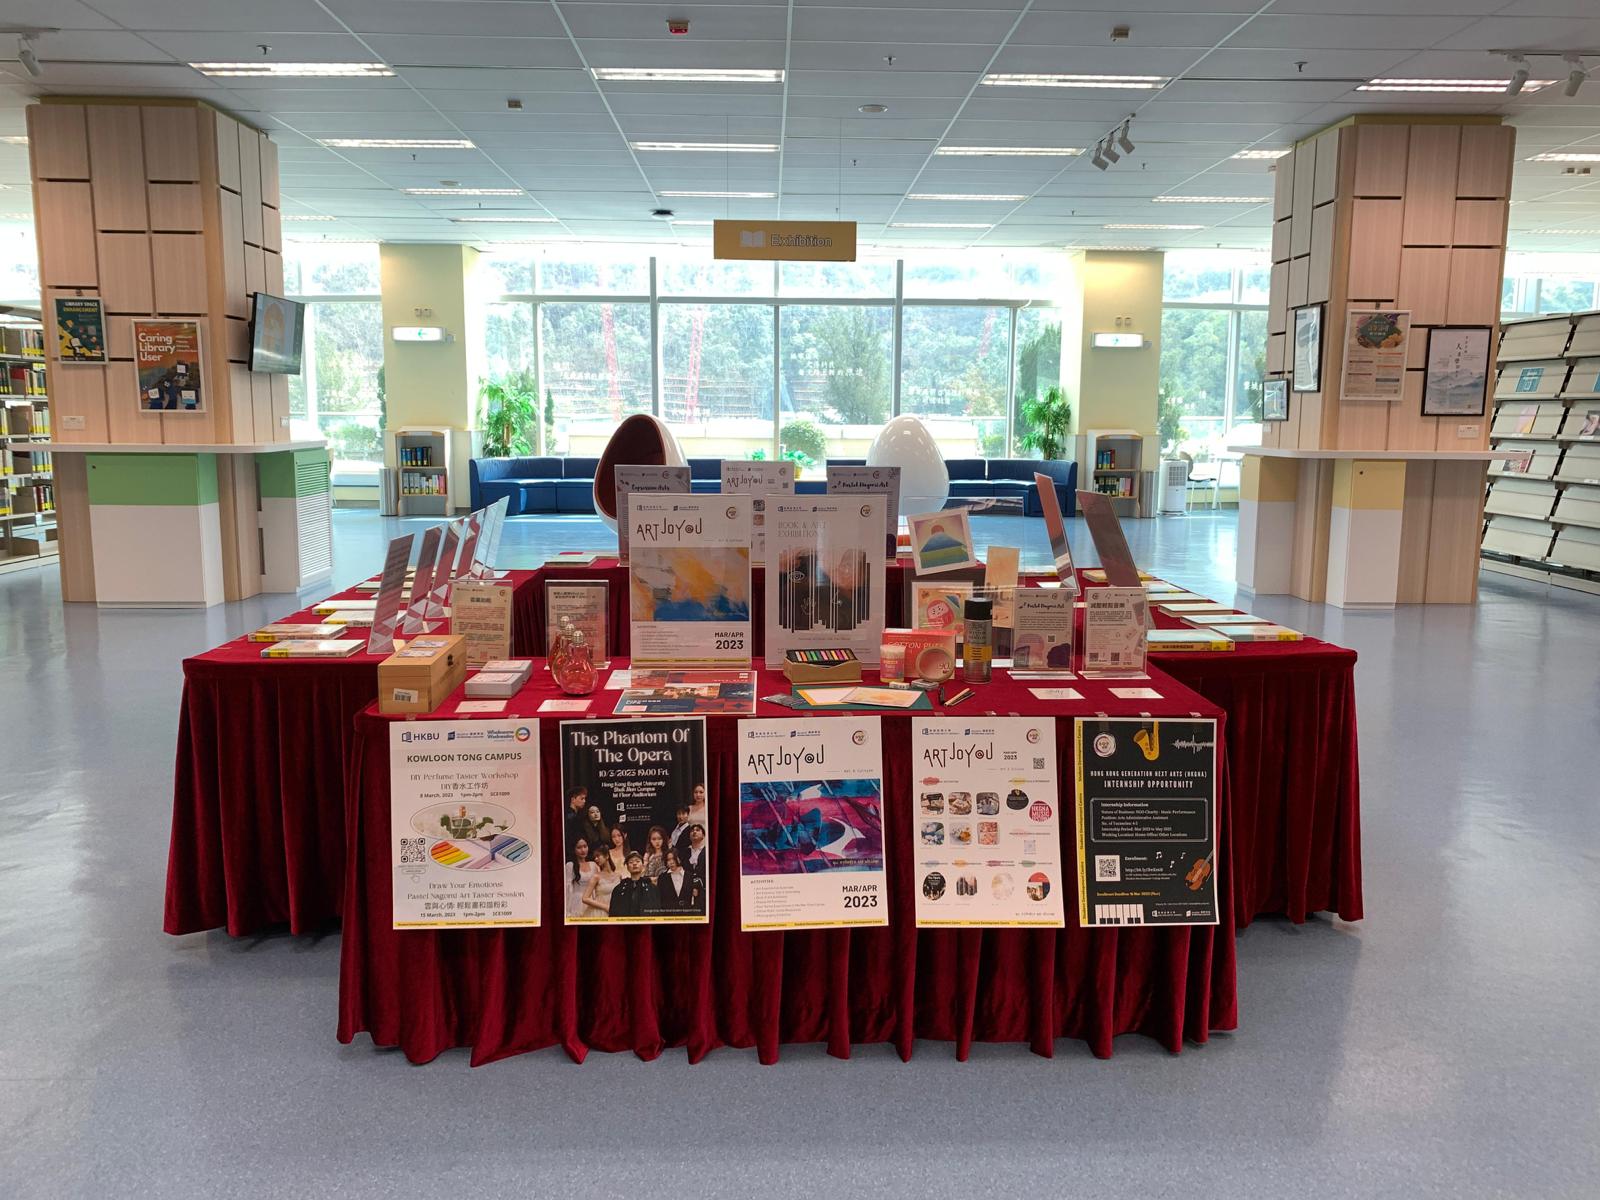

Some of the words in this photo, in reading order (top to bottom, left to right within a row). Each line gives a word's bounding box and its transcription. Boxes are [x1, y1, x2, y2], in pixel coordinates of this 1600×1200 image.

[771, 233, 833, 247] Exhibition
[138, 332, 173, 344] Caring
[139, 342, 176, 355] Library
[140, 351, 163, 361] User
[777, 521, 799, 529] BOOK
[801, 521, 807, 529] &
[810, 521, 827, 529] ART
[777, 529, 822, 538] EXHIBITION
[715, 640, 744, 650] 2023
[888, 641, 921, 649] COTTON
[413, 732, 440, 741] HKBU
[570, 731, 600, 746] The
[603, 730, 668, 745] Phantom
[672, 728, 690, 743] Of
[406, 754, 455, 763] KOWLOON
[456, 753, 482, 762] TONG
[484, 752, 522, 761] CAMPUS
[594, 748, 624, 763] The
[627, 747, 673, 765] Opera
[410, 773, 422, 781] DIY
[480, 772, 519, 781] Workshop
[599, 769, 637, 778] 10/3/2023
[1104, 780, 1145, 788] INTERNSHIP
[1147, 780, 1194, 788] OPPORTUNITY
[428, 882, 448, 890] Draw
[842, 884, 878, 893] MAR/APR
[407, 892, 429, 900] Pastel
[430, 892, 458, 901] Nagomi
[472, 891, 494, 899] Taster
[496, 891, 525, 899] Session
[844, 895, 878, 909] 2023
